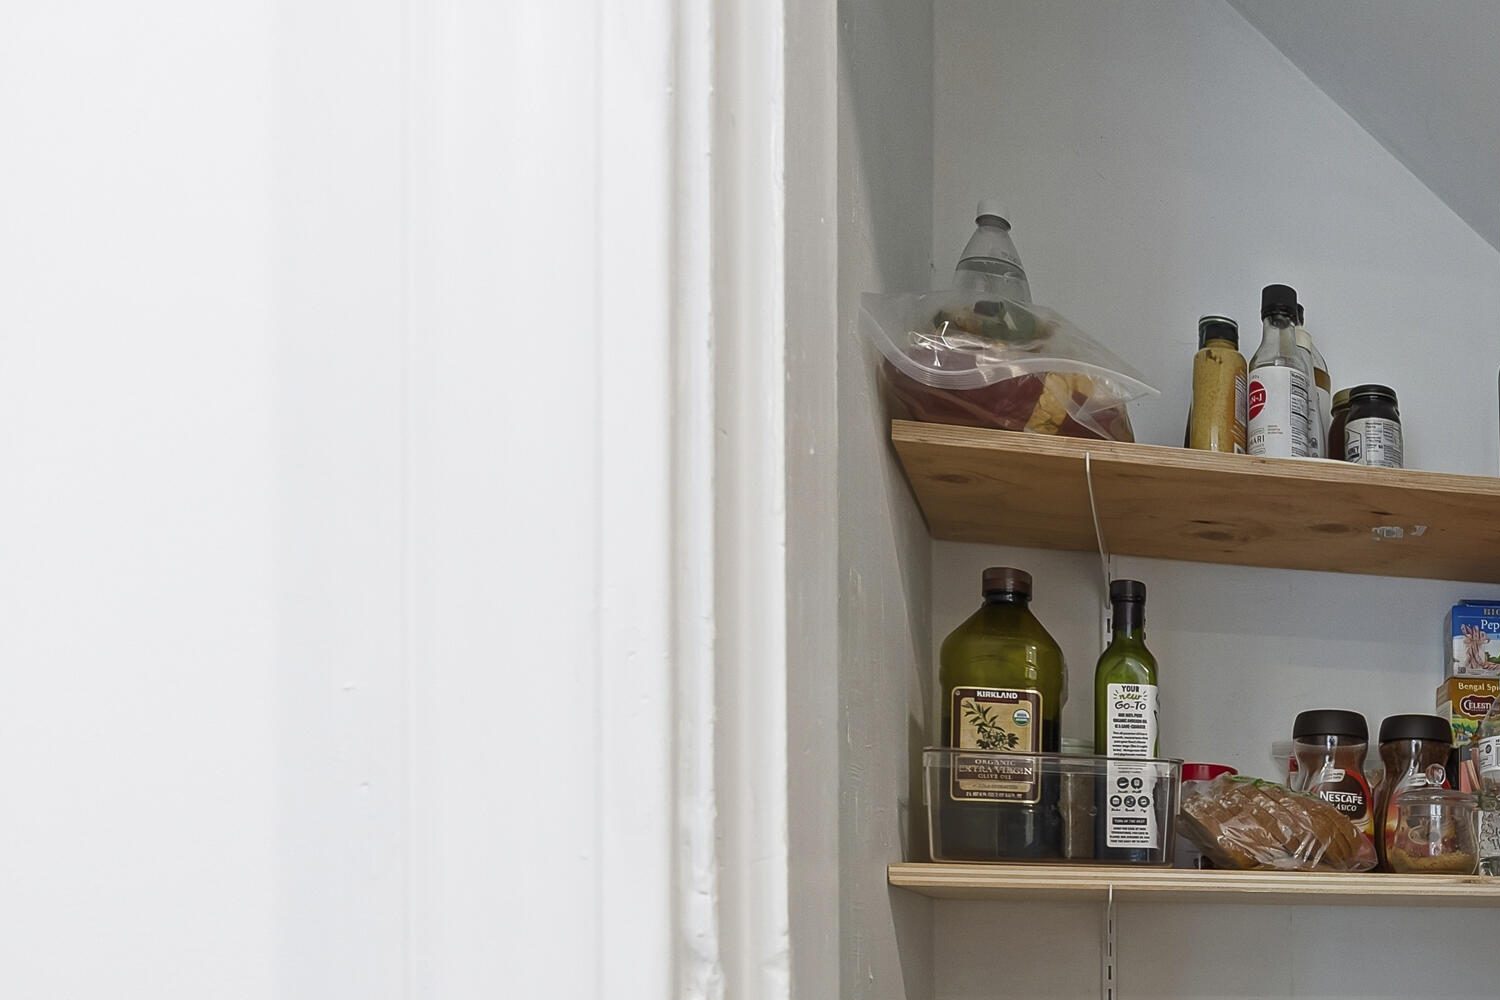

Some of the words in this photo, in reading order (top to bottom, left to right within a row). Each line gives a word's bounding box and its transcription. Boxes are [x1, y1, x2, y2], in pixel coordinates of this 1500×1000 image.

[1121, 685, 1140, 693] YOUR
[1458, 682, 1485, 692] Bengal
[976, 690, 1018, 699] KIRKLAND
[1463, 700, 1491, 710] CELEST
